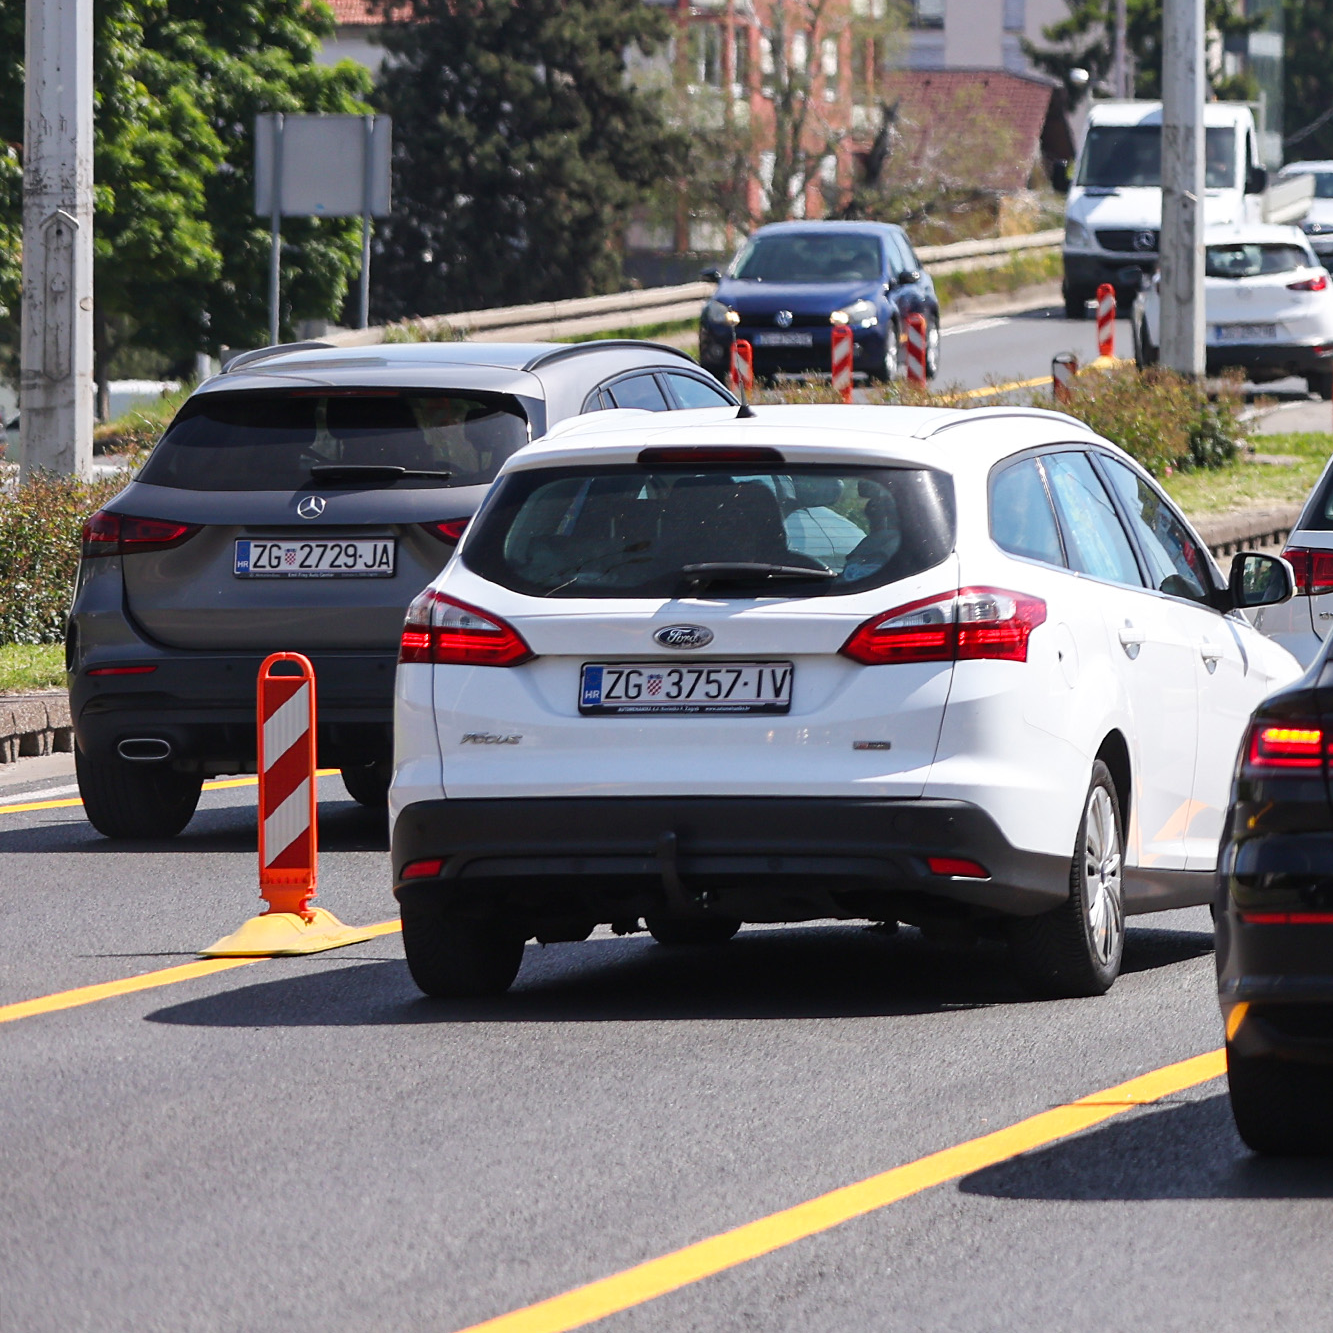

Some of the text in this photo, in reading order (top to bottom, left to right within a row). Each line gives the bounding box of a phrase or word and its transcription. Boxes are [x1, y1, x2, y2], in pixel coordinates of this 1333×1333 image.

[252, 543, 282, 569] ZG
[666, 629, 699, 643] Ford
[585, 690, 600, 699] HR
[605, 669, 643, 700] ZG
